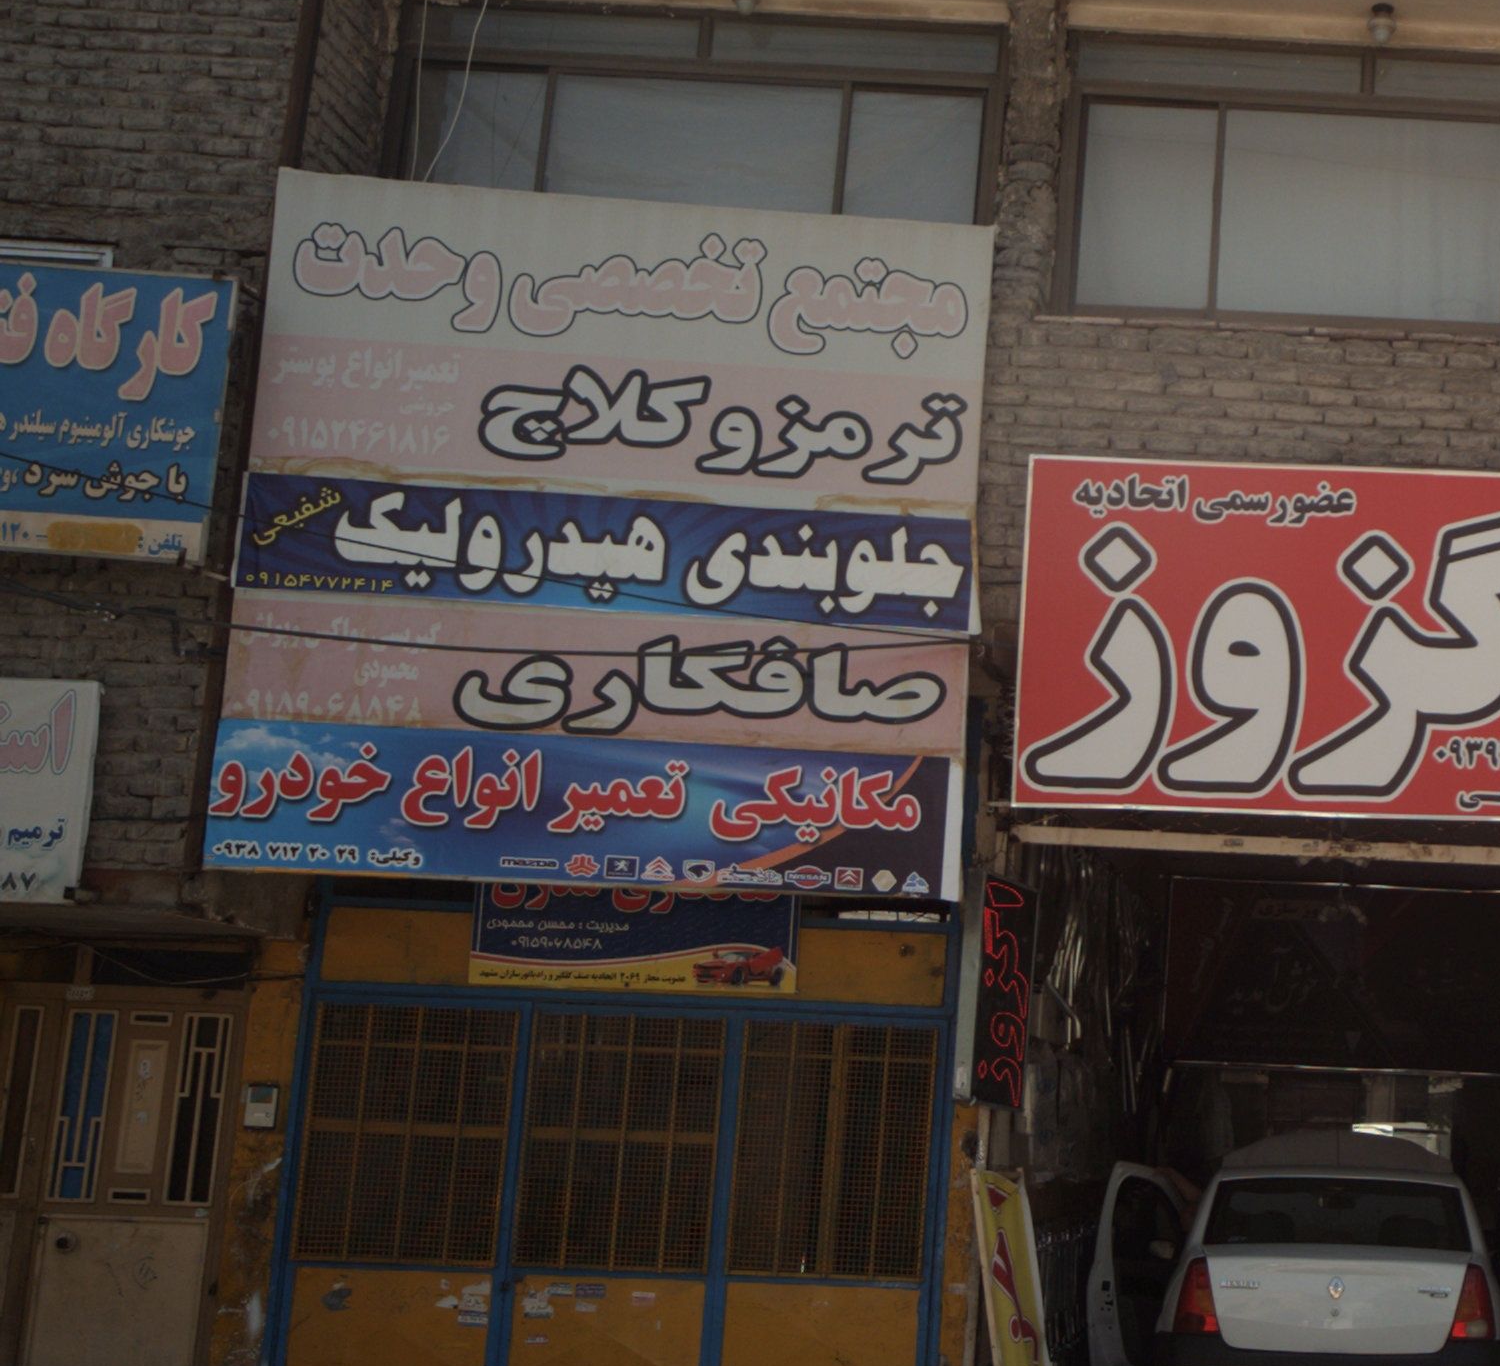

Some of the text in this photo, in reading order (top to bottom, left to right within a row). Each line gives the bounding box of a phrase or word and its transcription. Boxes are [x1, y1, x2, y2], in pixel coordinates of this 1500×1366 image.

[293, 222, 968, 359] مجتمع تخصصی وحدت
[44, 282, 218, 401] کارگاه
[342, 346, 403, 389] انواع
[400, 352, 461, 392] تعمیر
[9, 408, 57, 441] سیلندر
[59, 411, 128, 448] آلومینیوم
[480, 364, 712, 460] کلاچ
[126, 417, 196, 452] جوشکاری
[23, 460, 80, 496] سرد
[83, 460, 160, 501] جوش
[167, 463, 188, 504] با
[253, 486, 342, 546] شفیعی
[1074, 474, 1356, 525] عضو رسمی اتحادیه
[333, 491, 965, 617] جلوبندی هیدرولیک
[453, 634, 949, 735] صافکاری
[209, 742, 922, 843] مکانیکی تعمیر انواع خودرو
[8, 817, 68, 848] ترمیم
[787, 872, 828, 882] NISSAN
